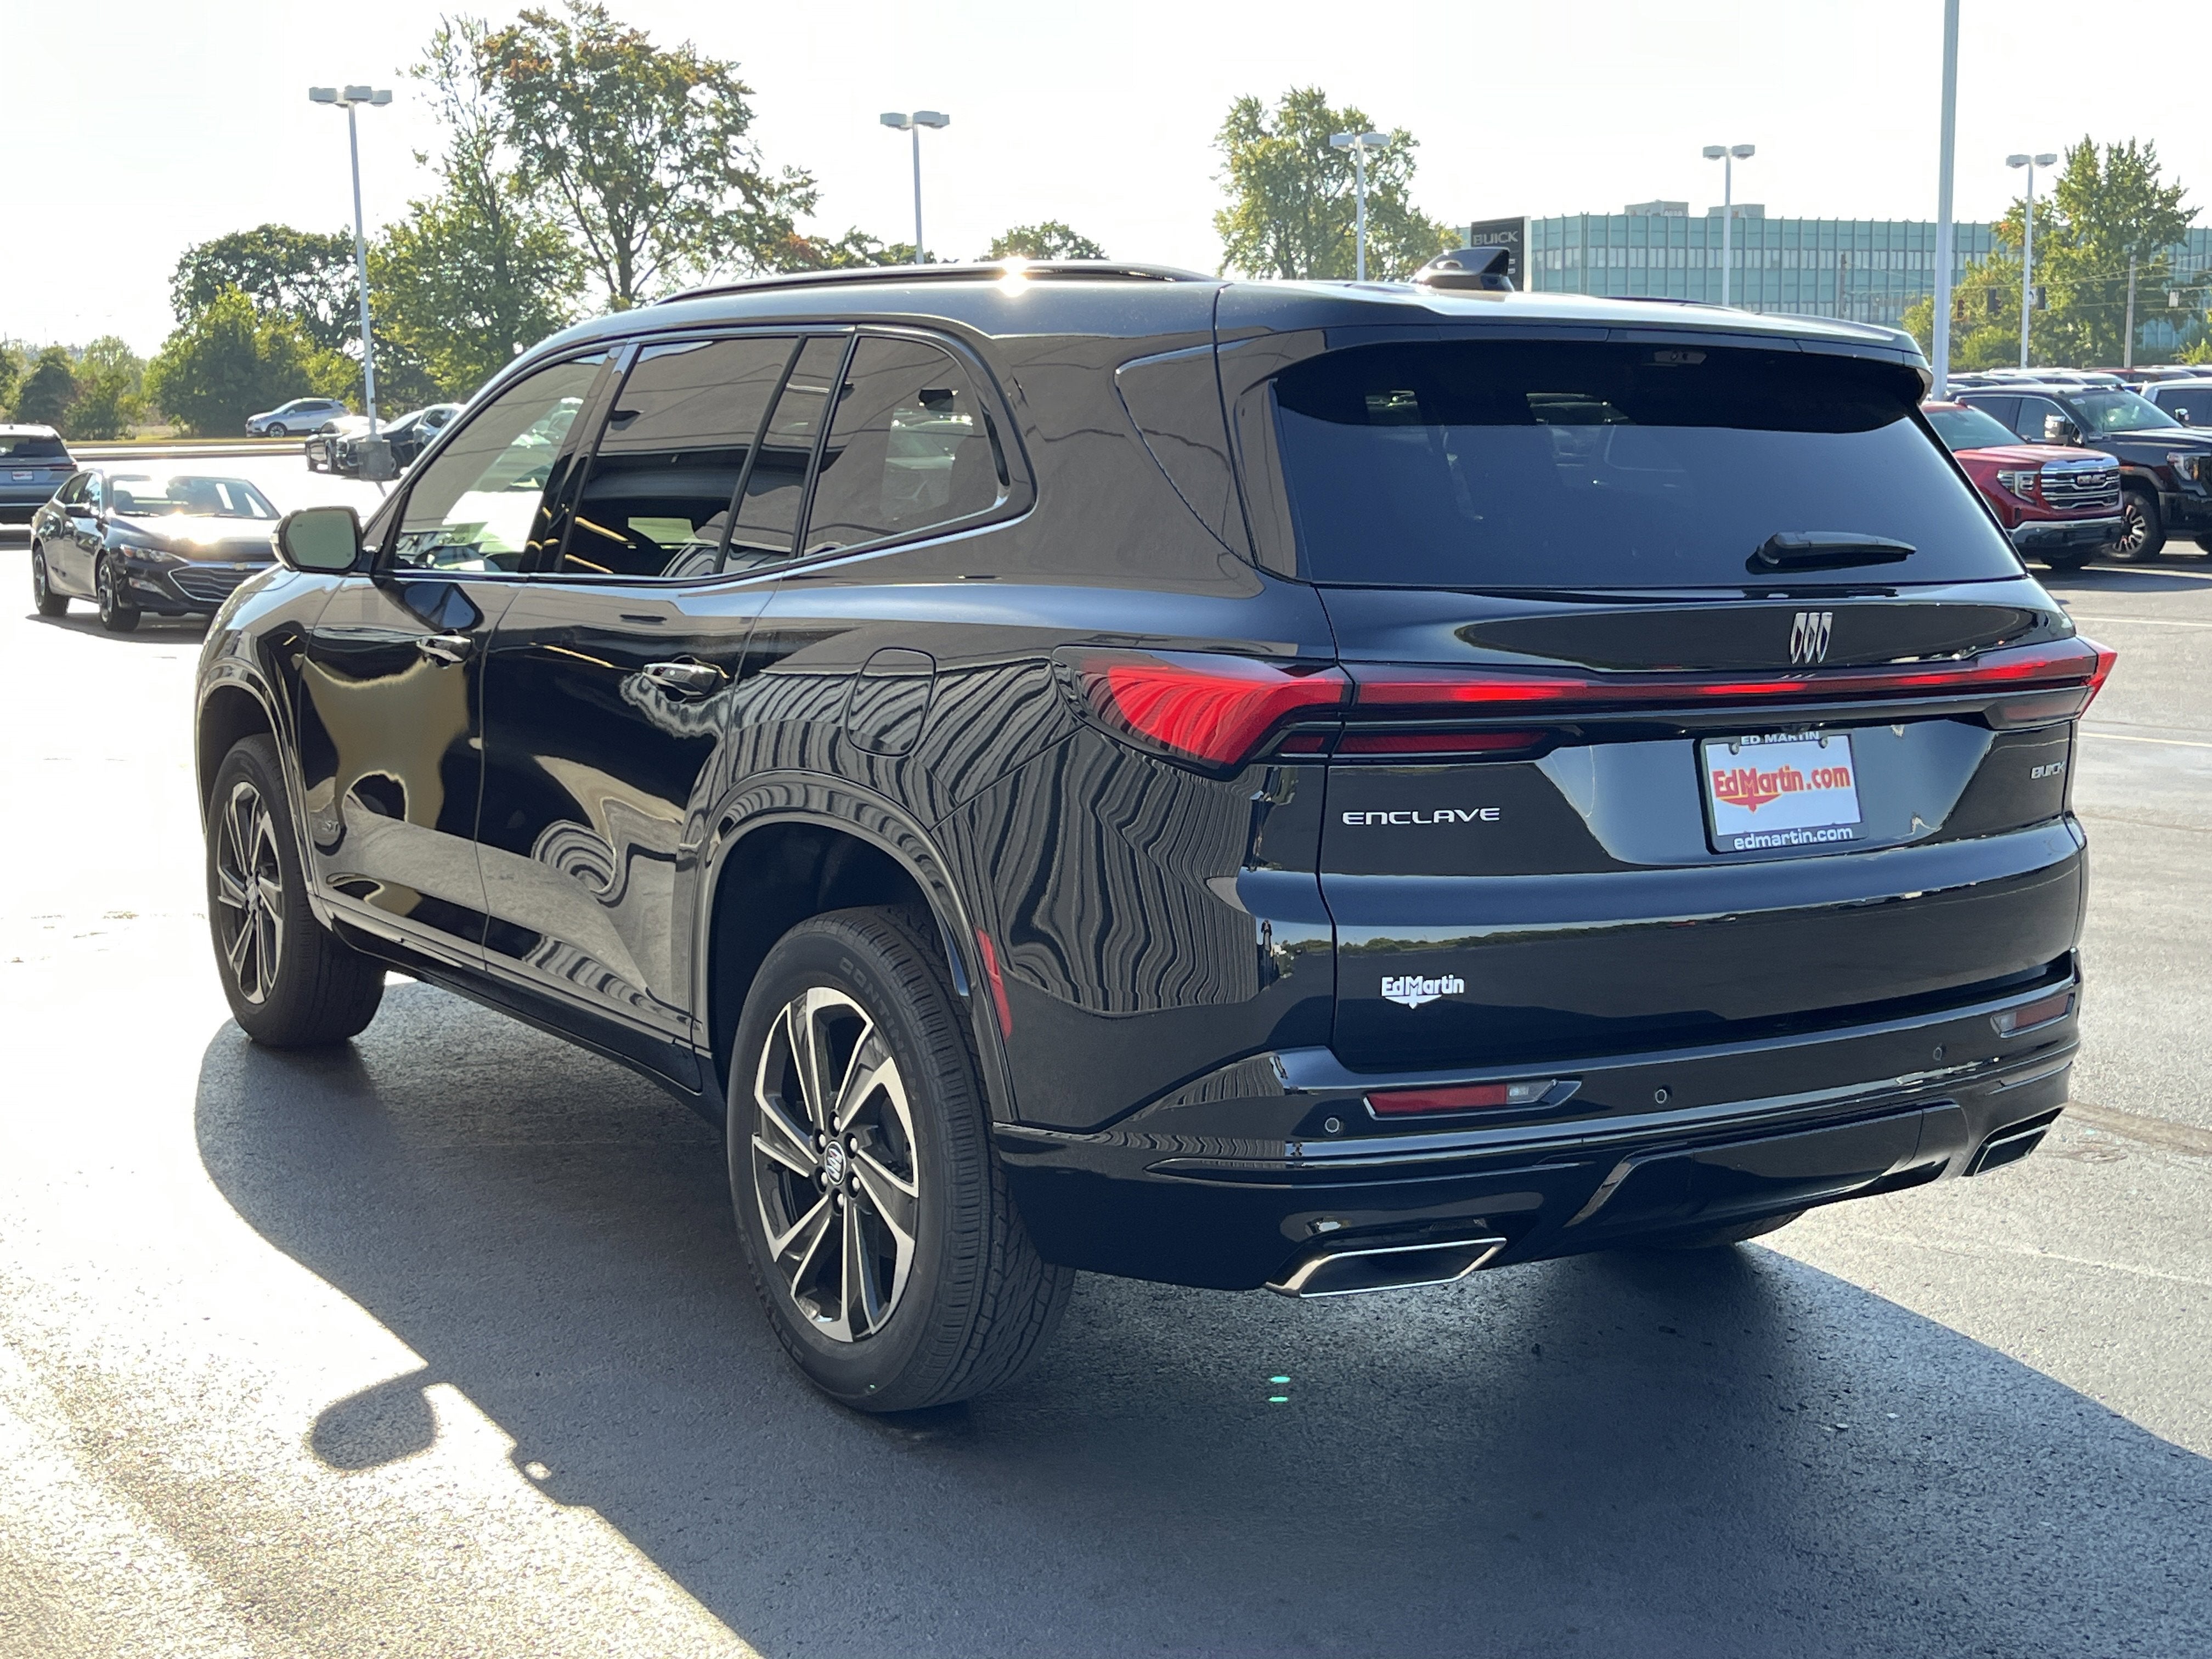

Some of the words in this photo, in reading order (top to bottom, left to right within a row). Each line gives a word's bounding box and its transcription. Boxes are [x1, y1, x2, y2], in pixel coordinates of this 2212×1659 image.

[1472, 230, 1518, 245] BUICK
[1741, 736, 1760, 745] ED
[1342, 808, 1500, 825] ENCLAVE
[1734, 828, 1853, 850] edmartin.com
